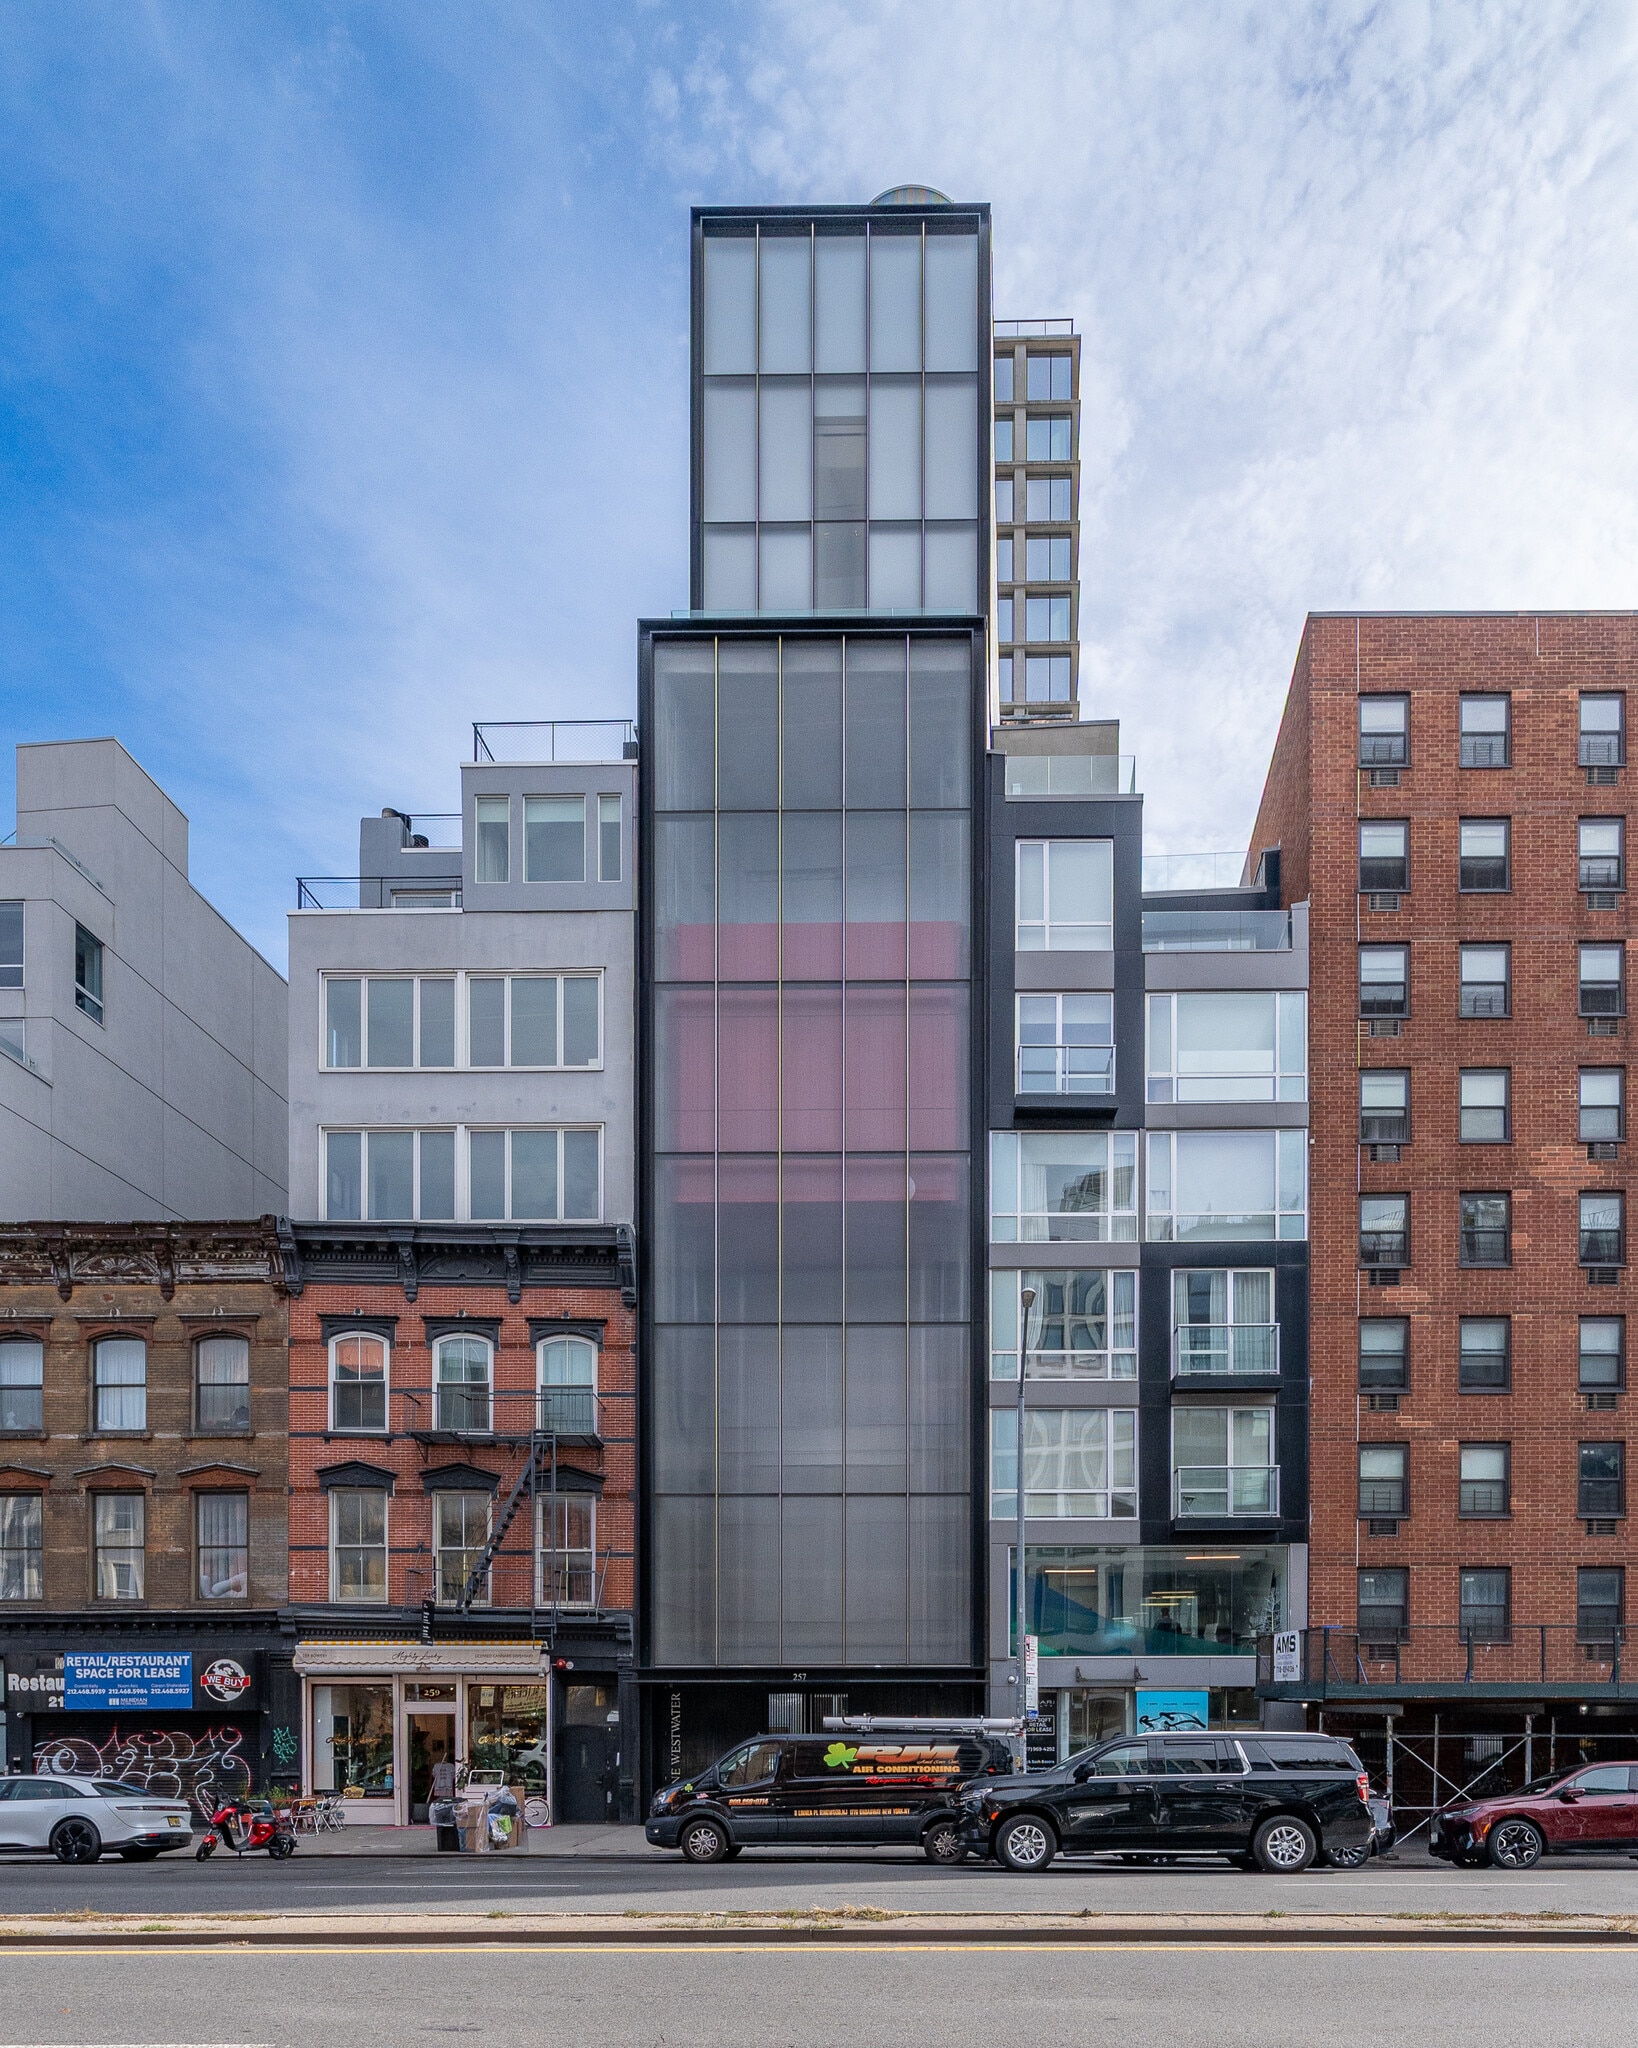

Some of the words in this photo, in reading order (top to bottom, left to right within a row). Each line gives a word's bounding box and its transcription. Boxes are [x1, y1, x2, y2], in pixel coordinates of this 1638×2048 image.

[1276, 1635, 1296, 1654] AMS
[66, 1656, 190, 1668] RETAIL/RESTAURANT
[392, 1651, 419, 1661] Mighty
[75, 1668, 114, 1679] SPACE
[116, 1668, 142, 1678] FOR
[144, 1667, 181, 1678] LEASE
[792, 1673, 807, 1681] 257
[206, 1675, 222, 1684] WE
[223, 1678, 245, 1687] BUY
[423, 1688, 440, 1697] 259
[670, 1692, 681, 1764] WESTWATER
[854, 1745, 961, 1763] PM
[852, 1765, 874, 1773] AIR
[876, 1765, 961, 1773] CONDITIONING
